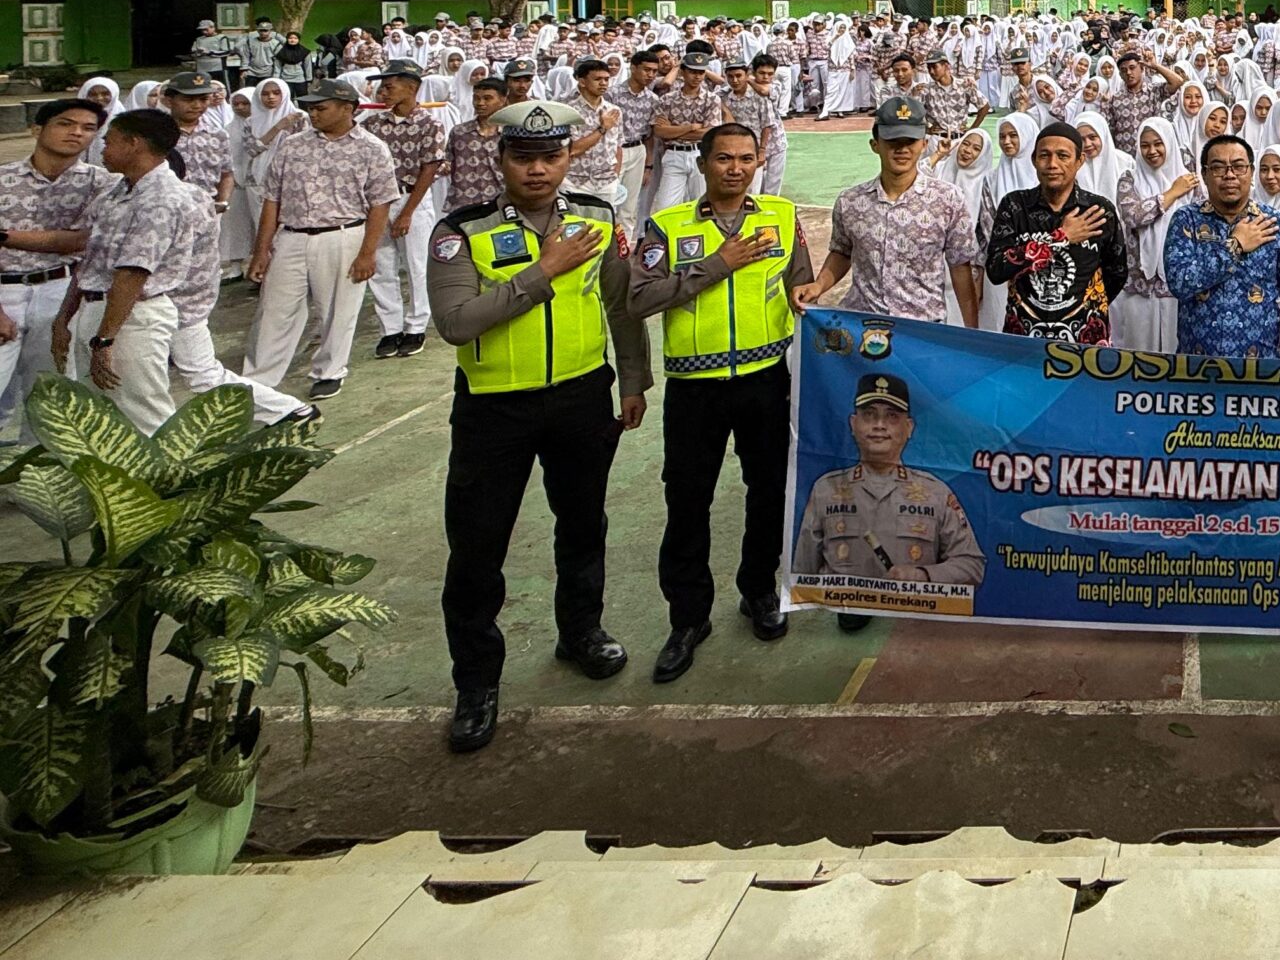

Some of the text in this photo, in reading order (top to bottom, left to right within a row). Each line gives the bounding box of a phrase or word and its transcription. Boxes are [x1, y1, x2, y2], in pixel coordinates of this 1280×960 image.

[1116, 393, 1215, 415] POLRES
[1165, 422, 1213, 453] Akan
[974, 451, 1051, 494] “OPS
[1059, 455, 1279, 501] KESELAMATAN
[900, 505, 934, 516] POLRI
[1069, 512, 1128, 530] Mulai
[1133, 515, 1202, 537] tanggal
[1206, 520, 1218, 533] 2
[1222, 517, 1253, 534] s.d.
[1258, 519, 1279, 534] 15
[1100, 550, 1234, 576] Kamseltibcarlantas
[1237, 558, 1273, 582] yang
[797, 576, 820, 585] AKBP
[822, 577, 845, 586] HARI
[848, 578, 899, 593] BUDIYANTO,
[950, 587, 970, 596] M.H.
[1078, 579, 1152, 607] menjelang
[1156, 581, 1248, 608] pelaksanaan
[1253, 584, 1279, 611] Ops
[825, 590, 936, 609] Kapolres Enrekang
